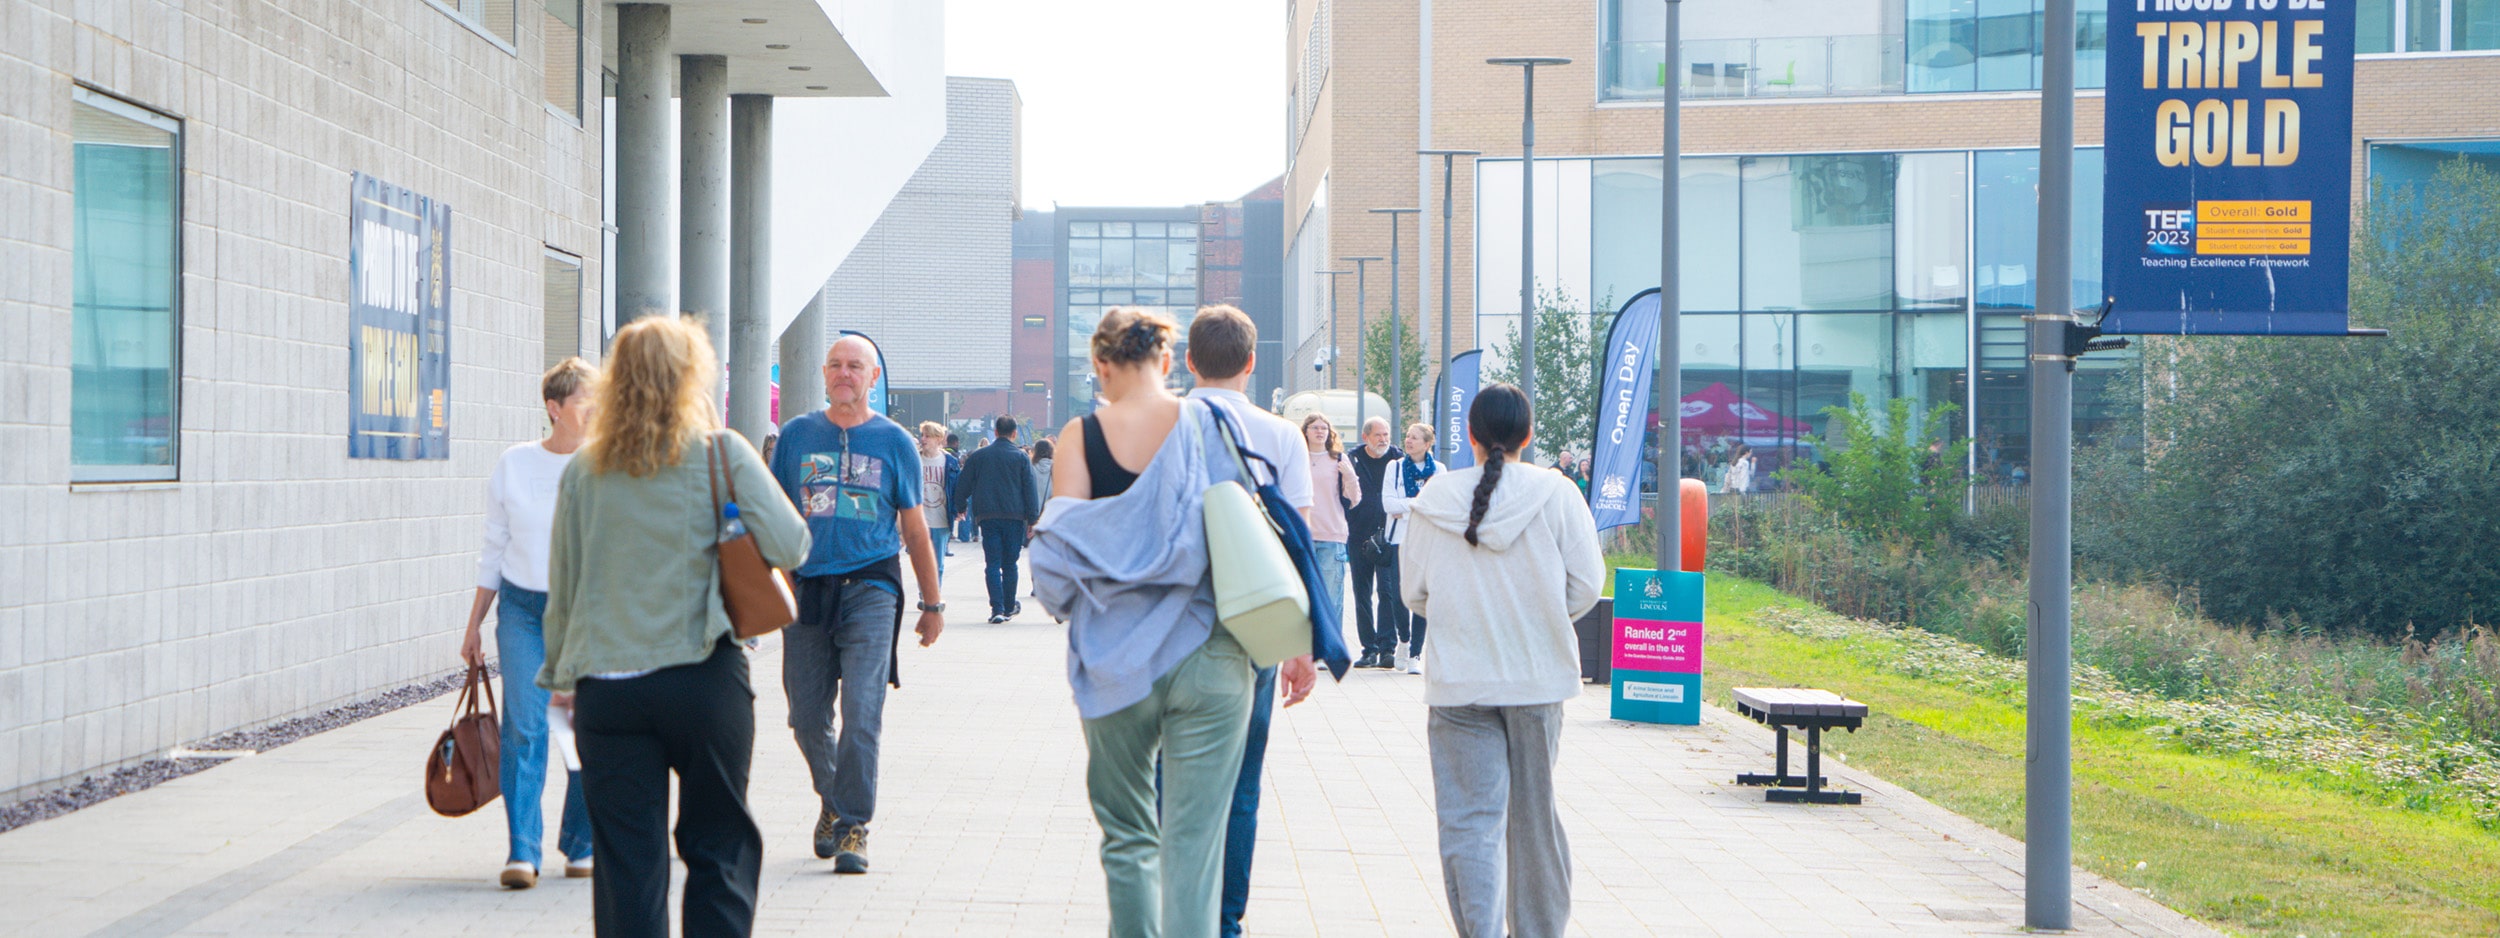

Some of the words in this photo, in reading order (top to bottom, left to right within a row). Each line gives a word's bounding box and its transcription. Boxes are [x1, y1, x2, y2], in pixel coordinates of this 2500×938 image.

[2136, 20, 2324, 89] TRIPLE
[2155, 99, 2300, 167] GOLD
[2145, 209, 2192, 230] TEF
[2209, 206, 2261, 217] Overall:
[2265, 206, 2298, 217] Gold
[2146, 230, 2190, 246] 2023
[2205, 227, 2235, 235] Student
[2283, 227, 2303, 235] Gold
[2208, 242, 2238, 250] Student
[2279, 242, 2298, 250] Gold
[362, 219, 392, 310] PROUD
[394, 228, 406, 313] TO
[407, 232, 419, 316] BE
[2141, 257, 2187, 269] Teaching
[2190, 257, 2246, 268] Excellence
[2249, 257, 2310, 268] Framework
[361, 324, 393, 416] TRIPLE
[395, 330, 418, 417] GOLD
[1619, 340, 1640, 382] Day
[1450, 386, 1465, 413] Day
[1450, 416, 1463, 454] Open
[1625, 626, 1664, 640] Ranked
[1667, 628, 1687, 641] 2nd
[1624, 643, 1647, 651] overall
[1648, 643, 1655, 651] in
[1656, 643, 1669, 652] the
[1671, 644, 1685, 653] UK
